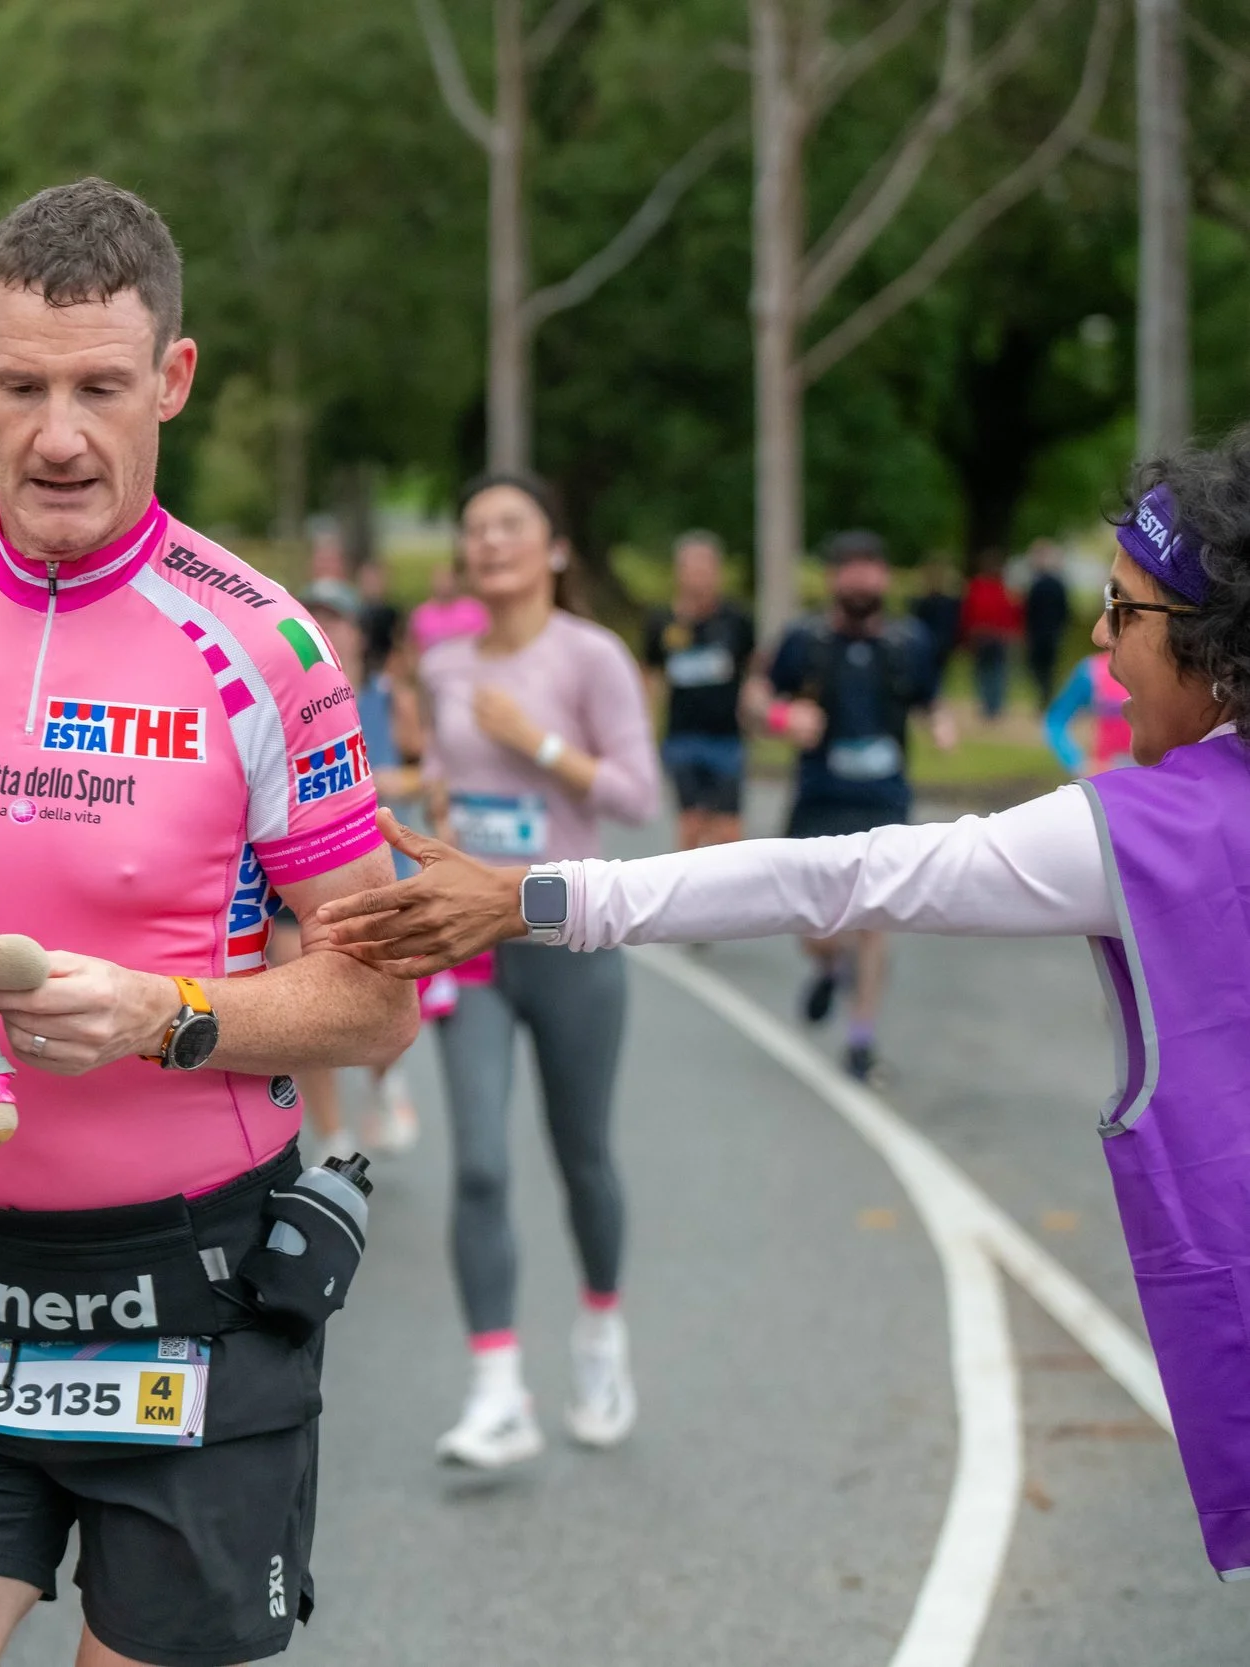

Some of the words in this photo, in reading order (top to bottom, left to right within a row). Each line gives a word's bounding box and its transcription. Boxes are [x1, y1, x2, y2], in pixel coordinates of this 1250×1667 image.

[161, 545, 277, 609] Santini
[24, 766, 73, 799] dello
[74, 769, 135, 807] Sport
[39, 807, 72, 822] della
[75, 811, 101, 825] vita
[150, 1375, 172, 1400] 4
[144, 1405, 174, 1421] KM
[269, 1554, 287, 1618] 2XU
